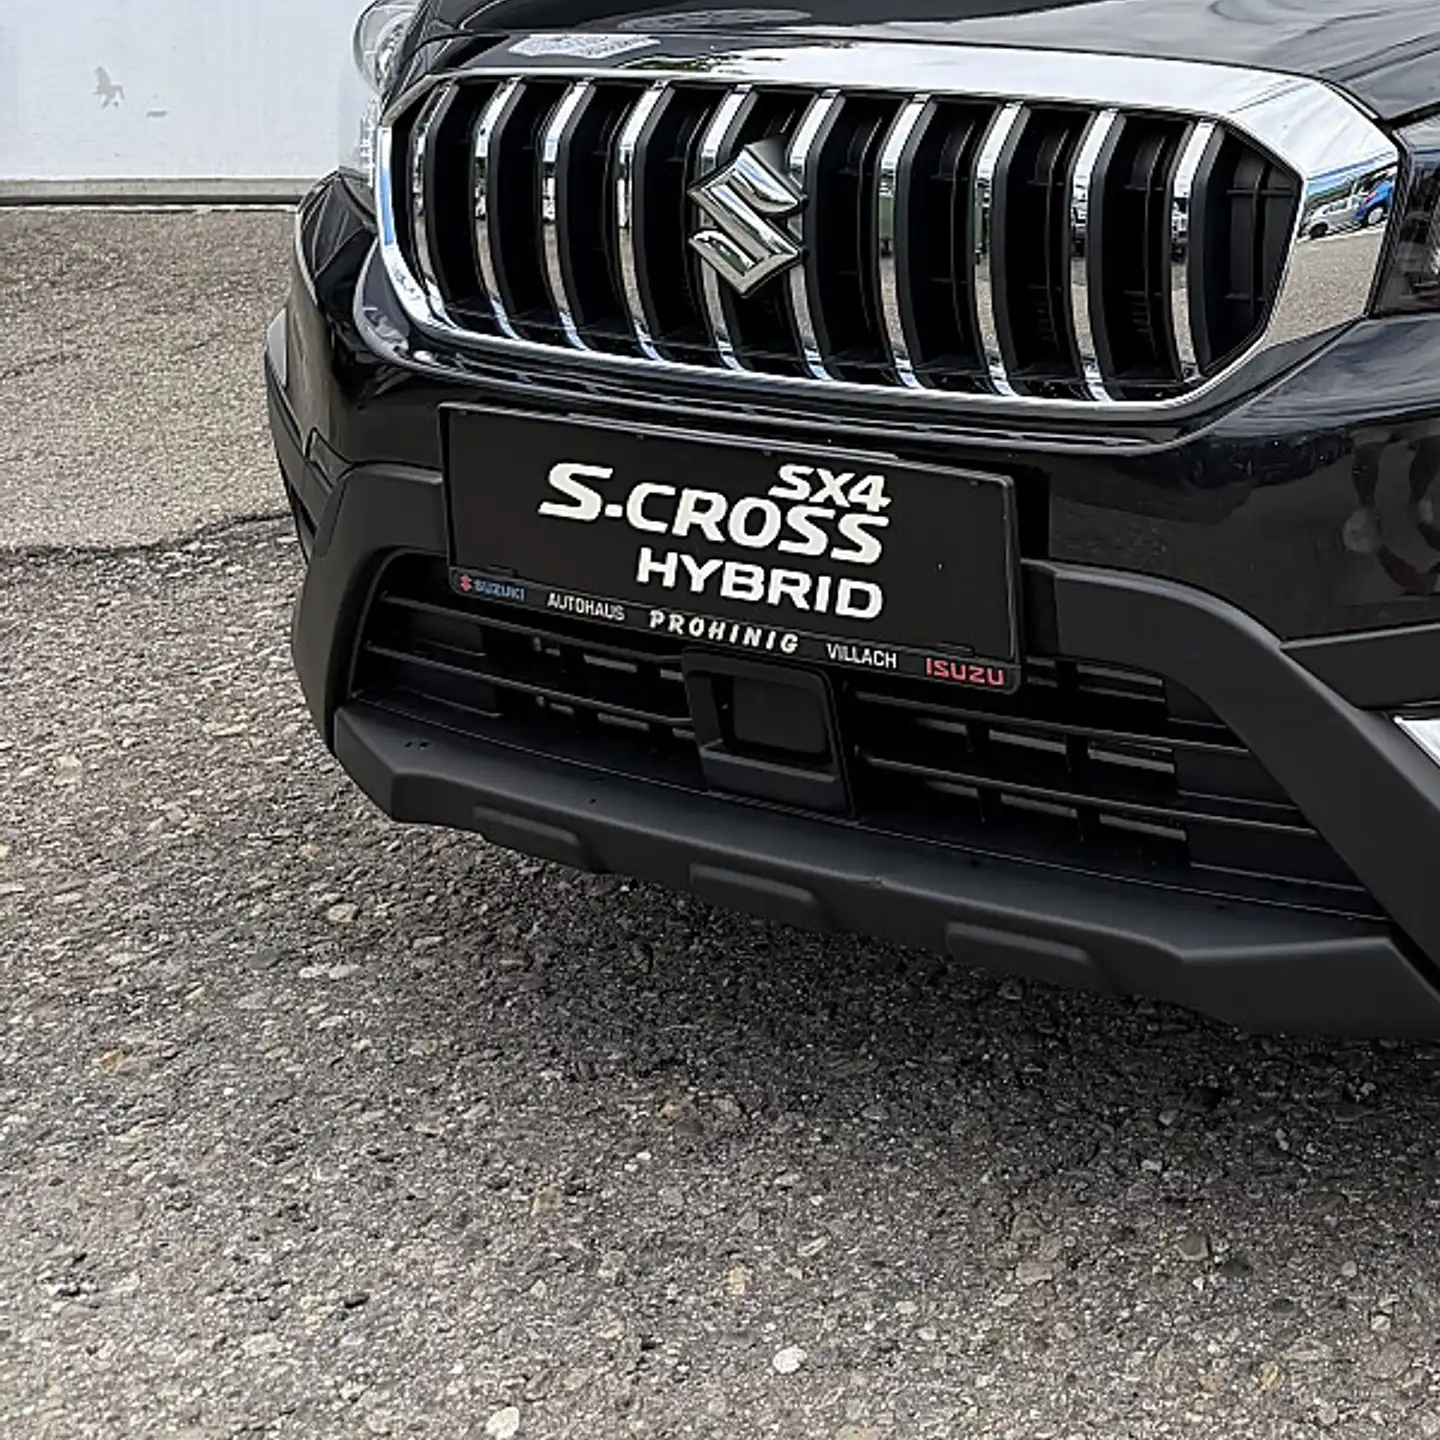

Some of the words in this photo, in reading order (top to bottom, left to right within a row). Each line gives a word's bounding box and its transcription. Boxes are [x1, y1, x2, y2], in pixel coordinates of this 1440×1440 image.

[767, 463, 892, 513] SX4
[636, 547, 884, 620] HYBRID
[474, 579, 525, 602] SUZUKI
[547, 592, 626, 622] AUTOHAUS
[650, 610, 799, 654] PROHINIG
[826, 643, 897, 669] VILLACH
[926, 658, 1005, 686] ISUZU
